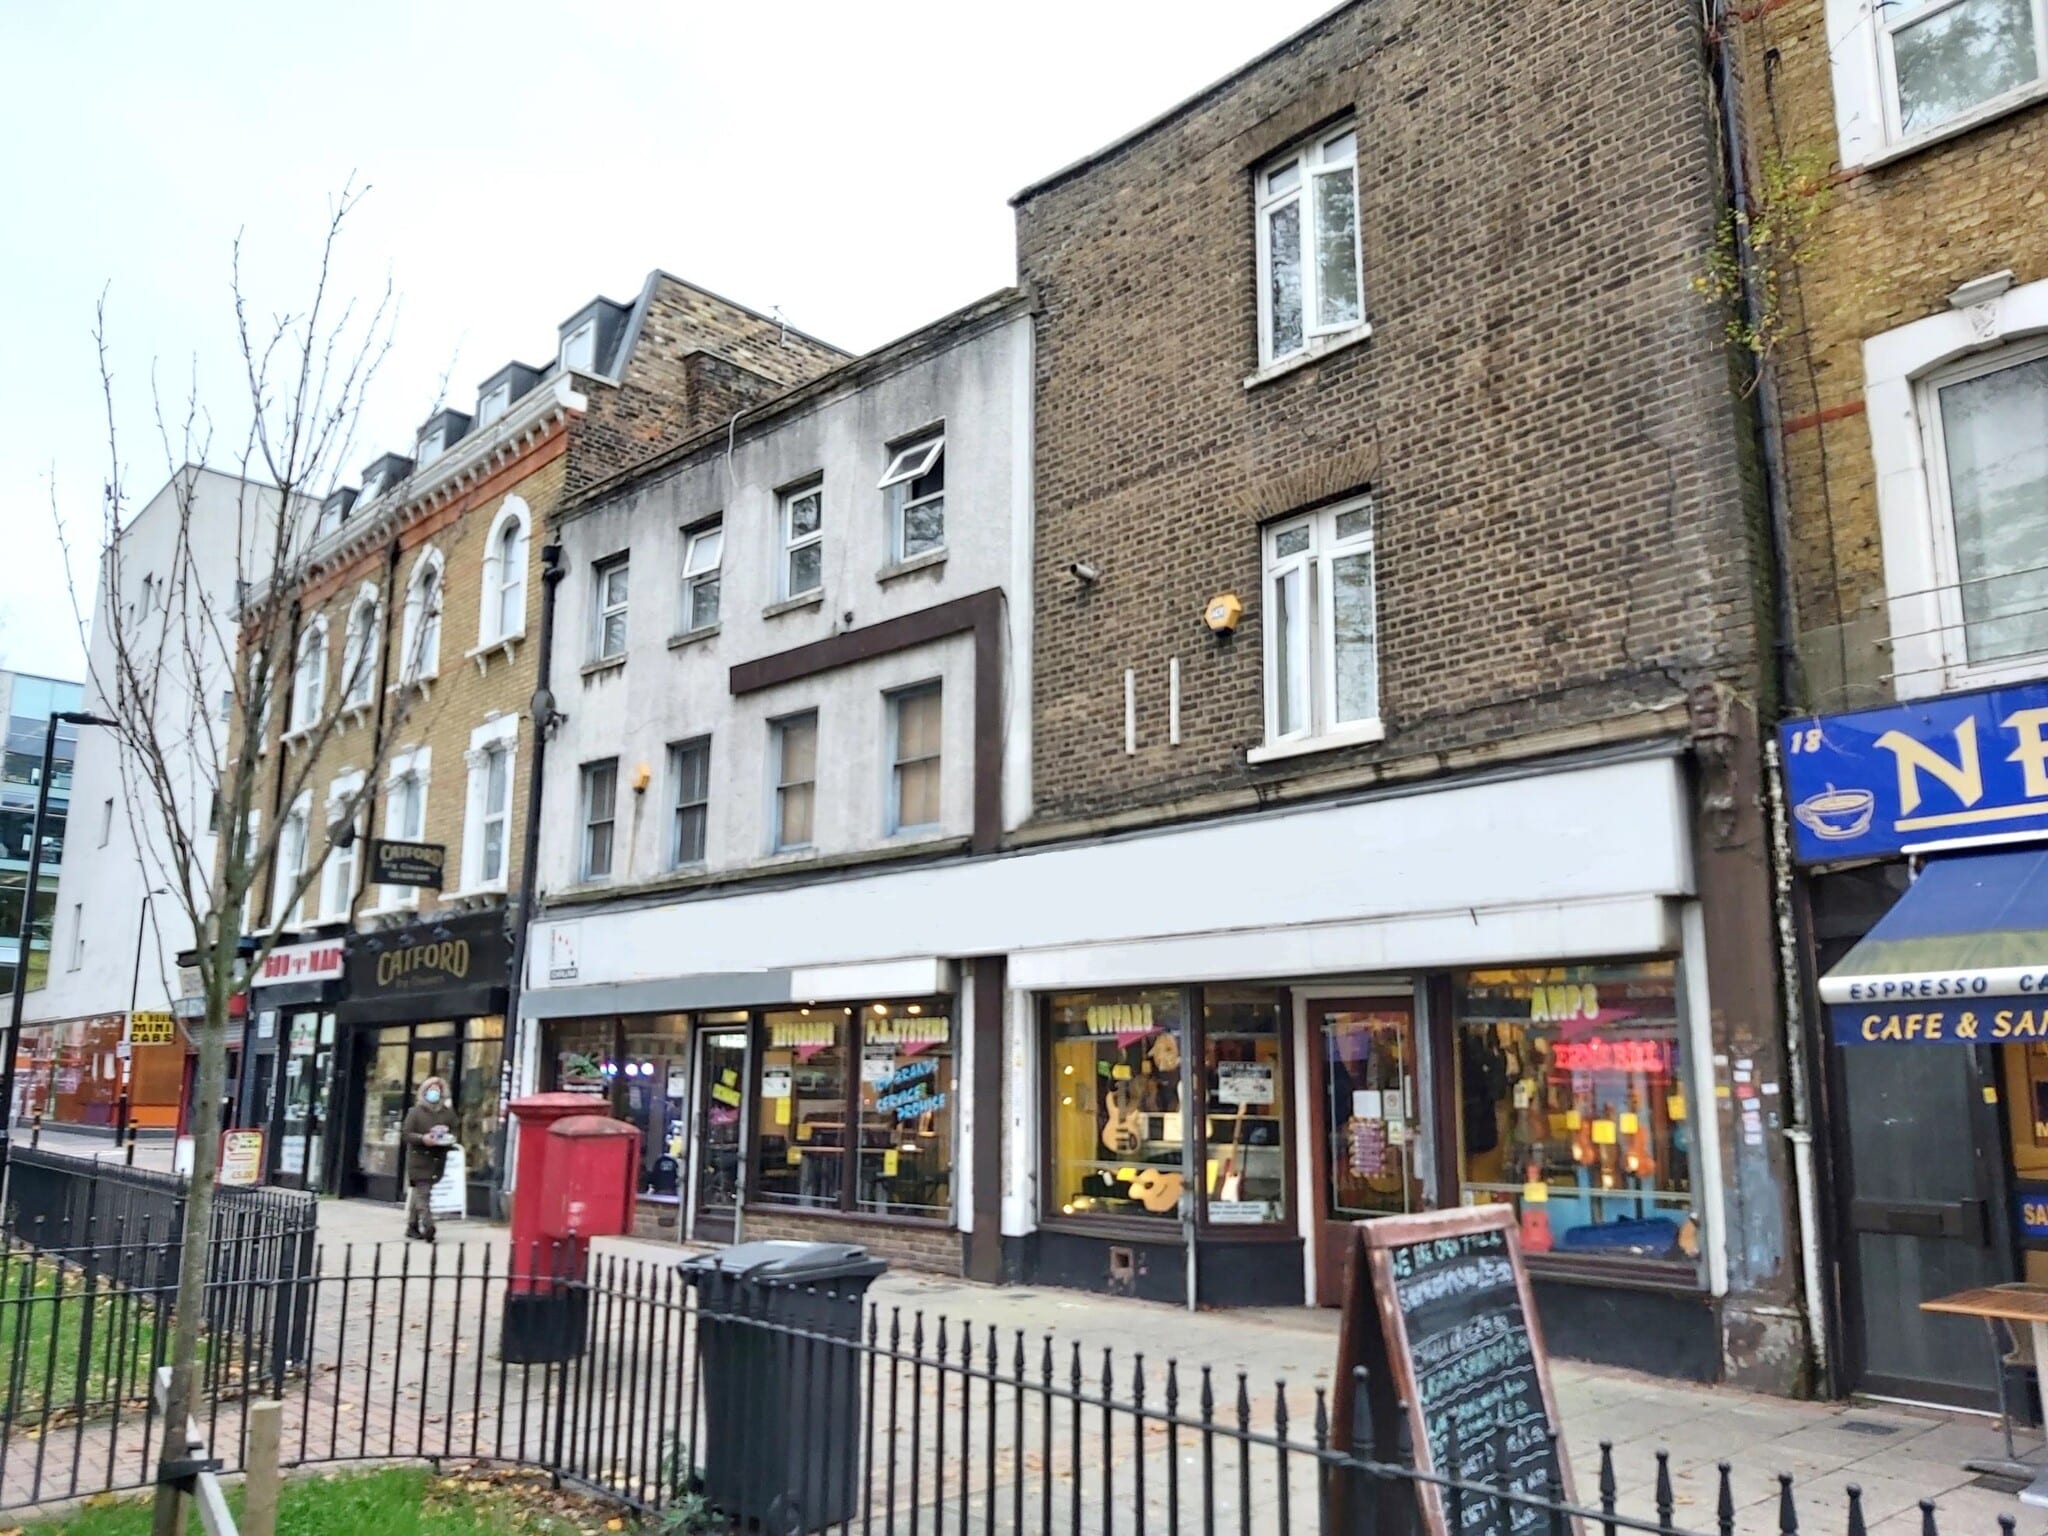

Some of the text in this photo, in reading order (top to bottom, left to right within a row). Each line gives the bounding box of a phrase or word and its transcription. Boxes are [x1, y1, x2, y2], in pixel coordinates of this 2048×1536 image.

[1791, 730, 1822, 753] 18
[380, 844, 443, 867] CATFORD
[376, 939, 470, 986] CATFORD
[1850, 976, 1988, 1000] ESPRESSO
[130, 1033, 173, 1042] CABS
[132, 1024, 170, 1032] MINI
[1861, 1012, 1944, 1041] CAFE
[1956, 1011, 1979, 1039] &
